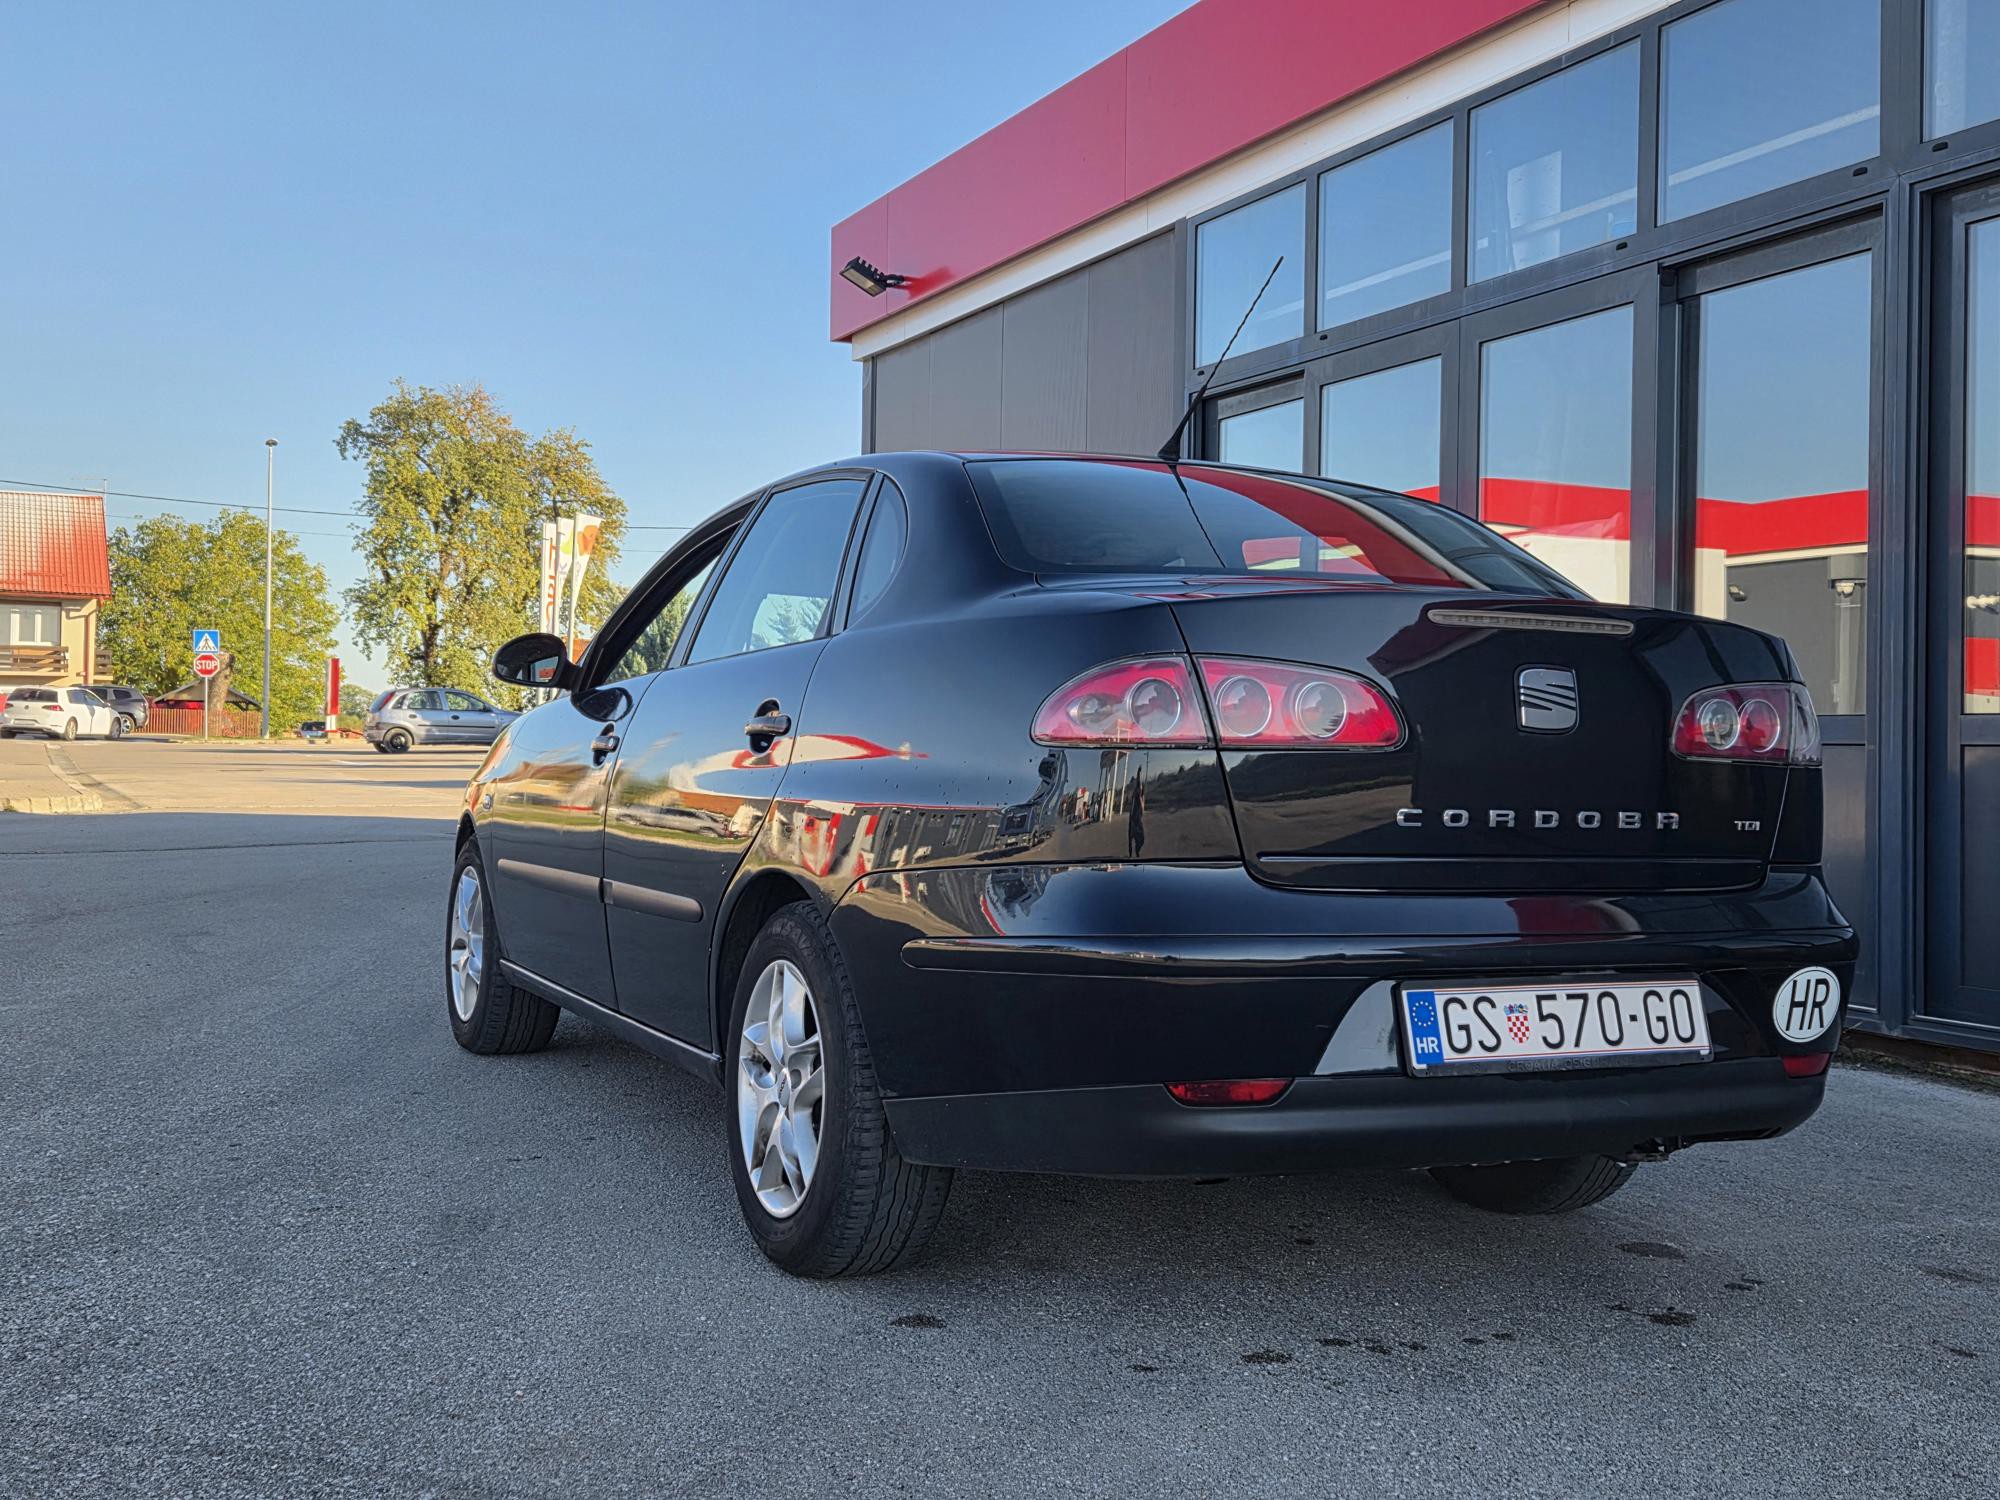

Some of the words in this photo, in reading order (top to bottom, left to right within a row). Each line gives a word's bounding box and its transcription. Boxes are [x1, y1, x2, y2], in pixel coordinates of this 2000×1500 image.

[196, 660, 218, 670] STOP
[1396, 807, 1680, 830] CORDOBA
[1733, 819, 1761, 832] TDI
[1785, 977, 1831, 1032] HR
[1443, 995, 1502, 1055] GS
[1535, 988, 1696, 1050] 570-GO
[1415, 1035, 1440, 1055] HR
